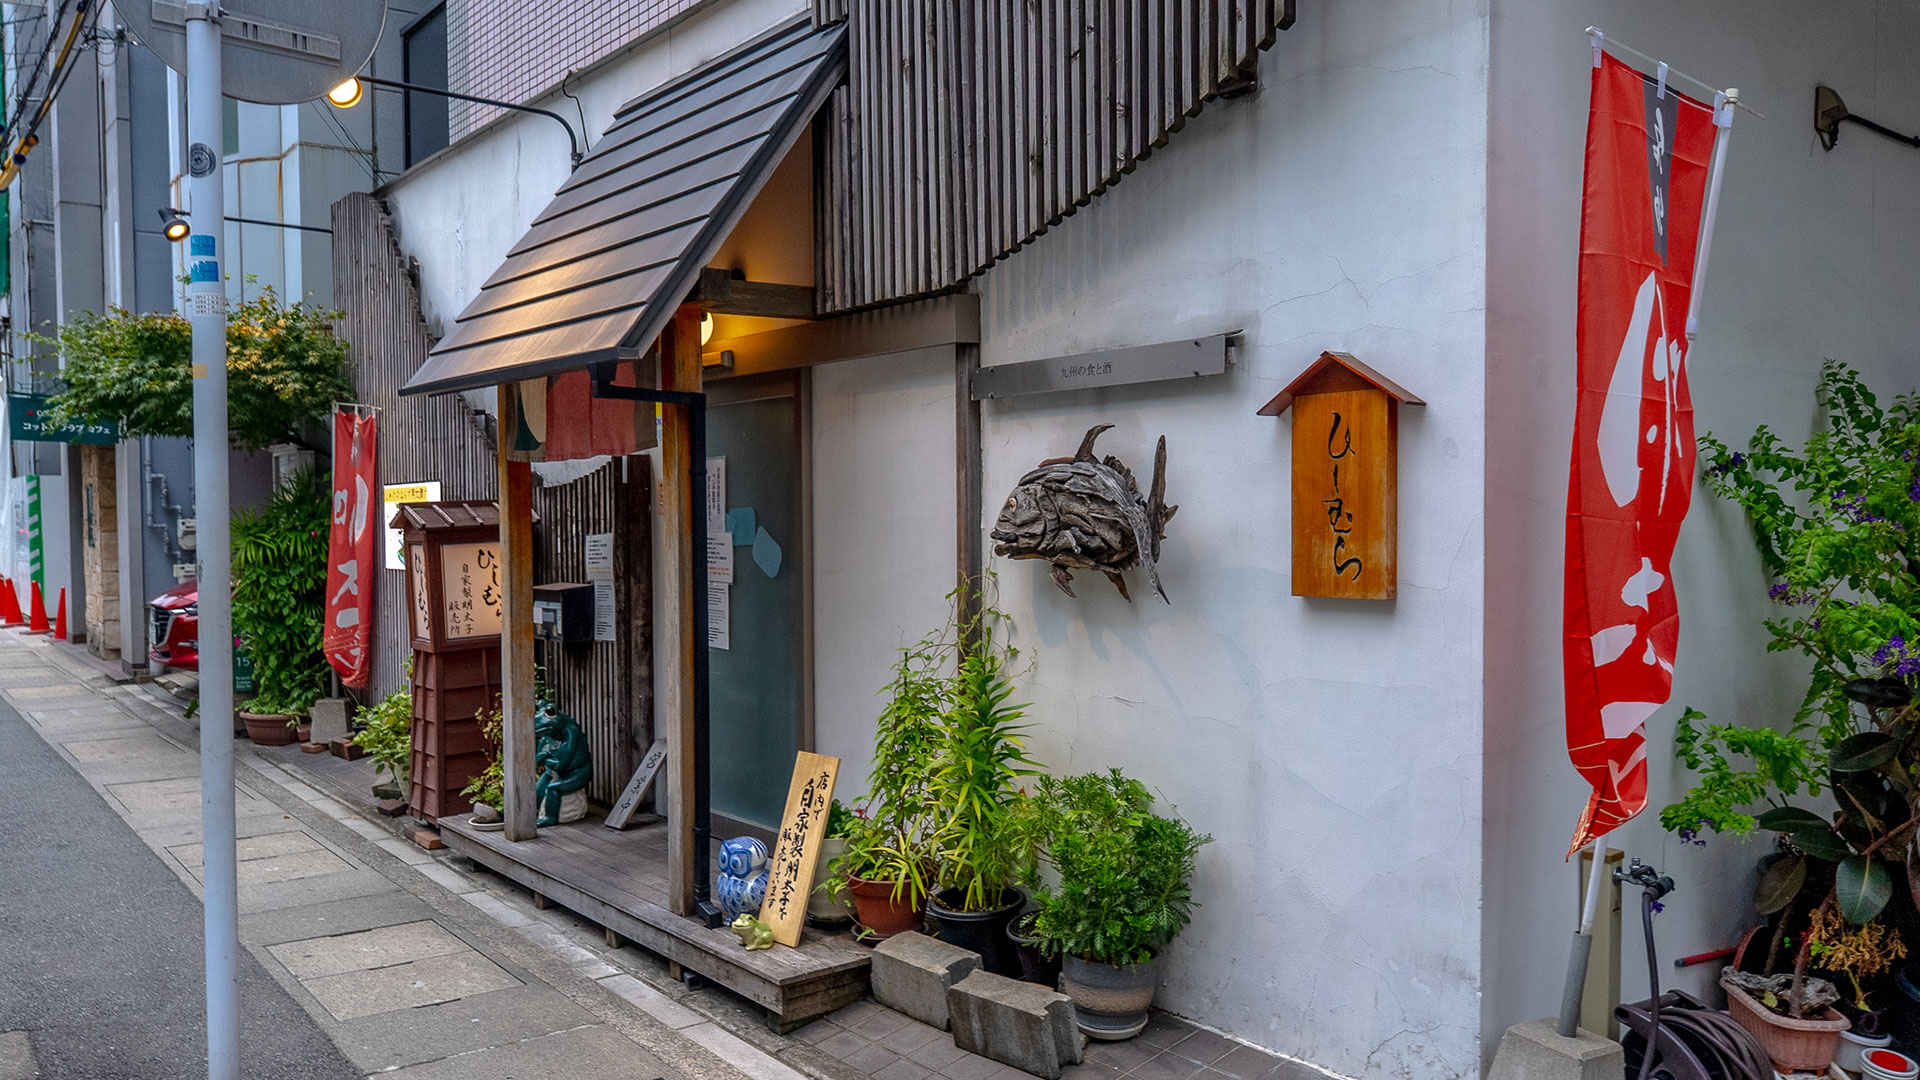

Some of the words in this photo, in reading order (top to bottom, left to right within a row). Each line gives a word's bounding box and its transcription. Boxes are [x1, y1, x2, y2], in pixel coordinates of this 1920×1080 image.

[1060, 361, 1112, 378] 九州の食と酒
[478, 548, 502, 618] ひしむ
[814, 771, 830, 820] 店内で
